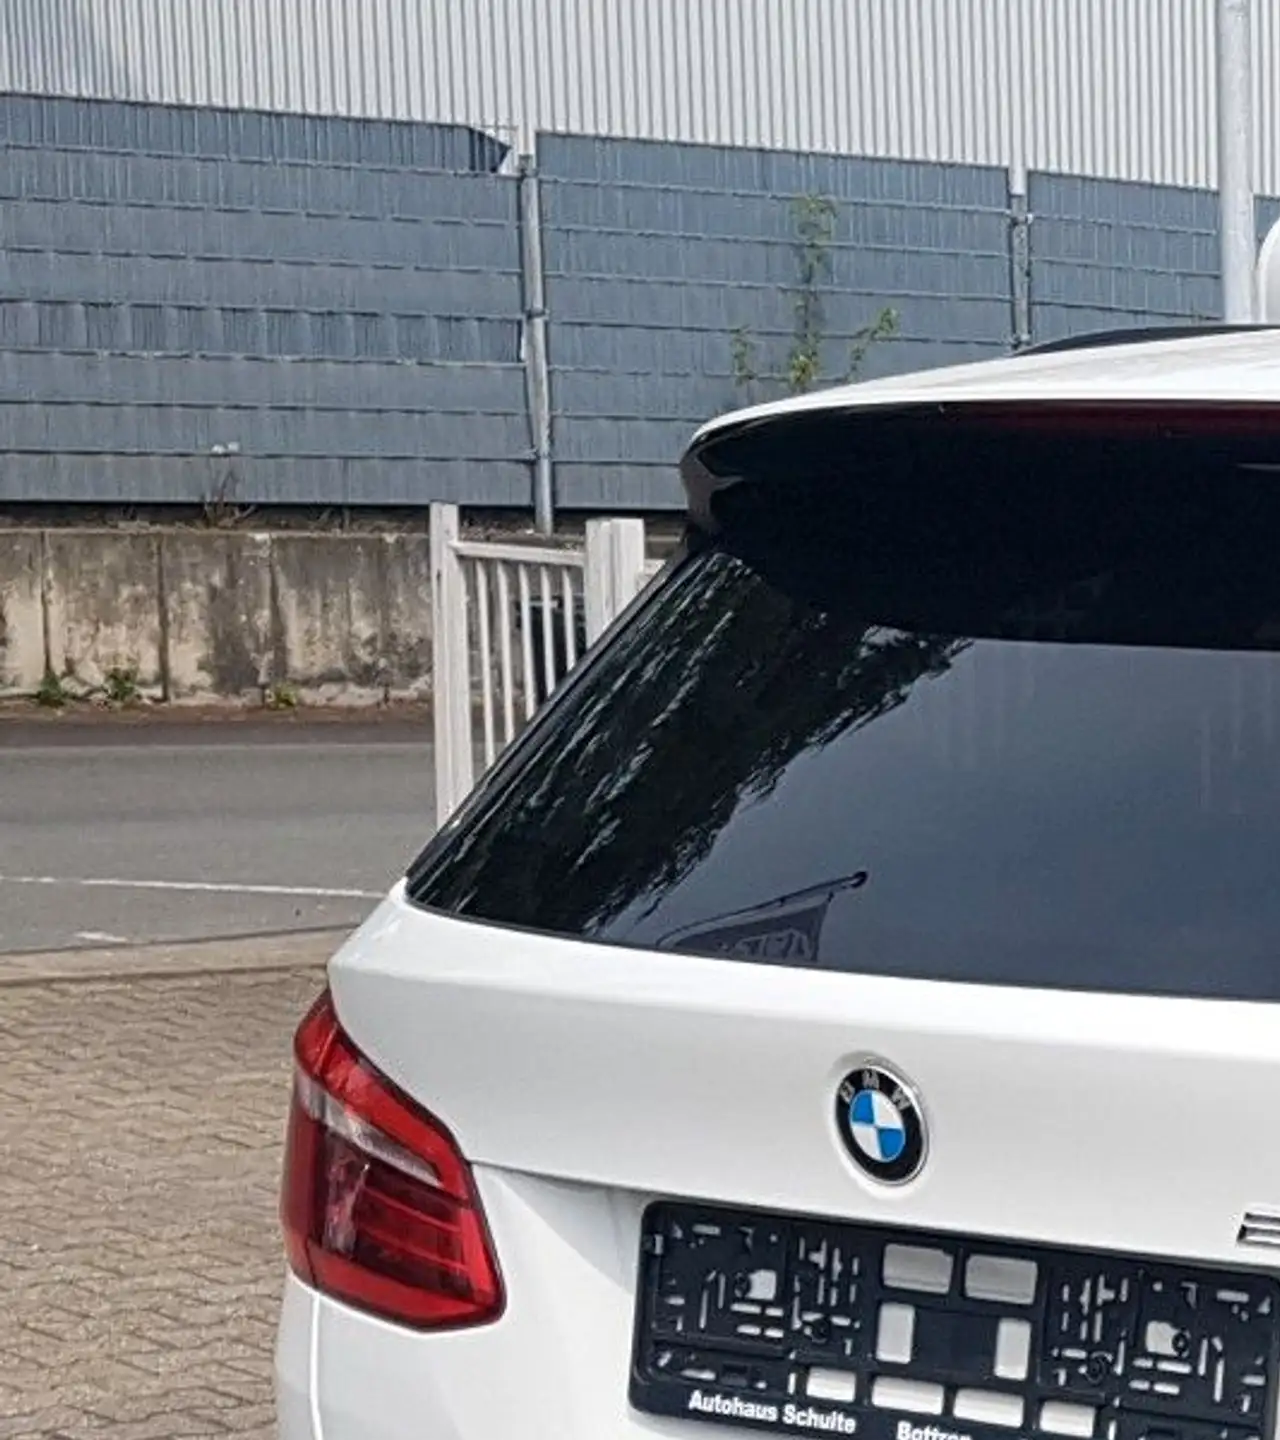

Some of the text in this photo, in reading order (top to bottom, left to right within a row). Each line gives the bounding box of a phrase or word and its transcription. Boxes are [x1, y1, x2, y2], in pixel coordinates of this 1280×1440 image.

[839, 1068, 913, 1112] BMW
[688, 1388, 779, 1423] Autohaus
[782, 1403, 857, 1434] Schulte
